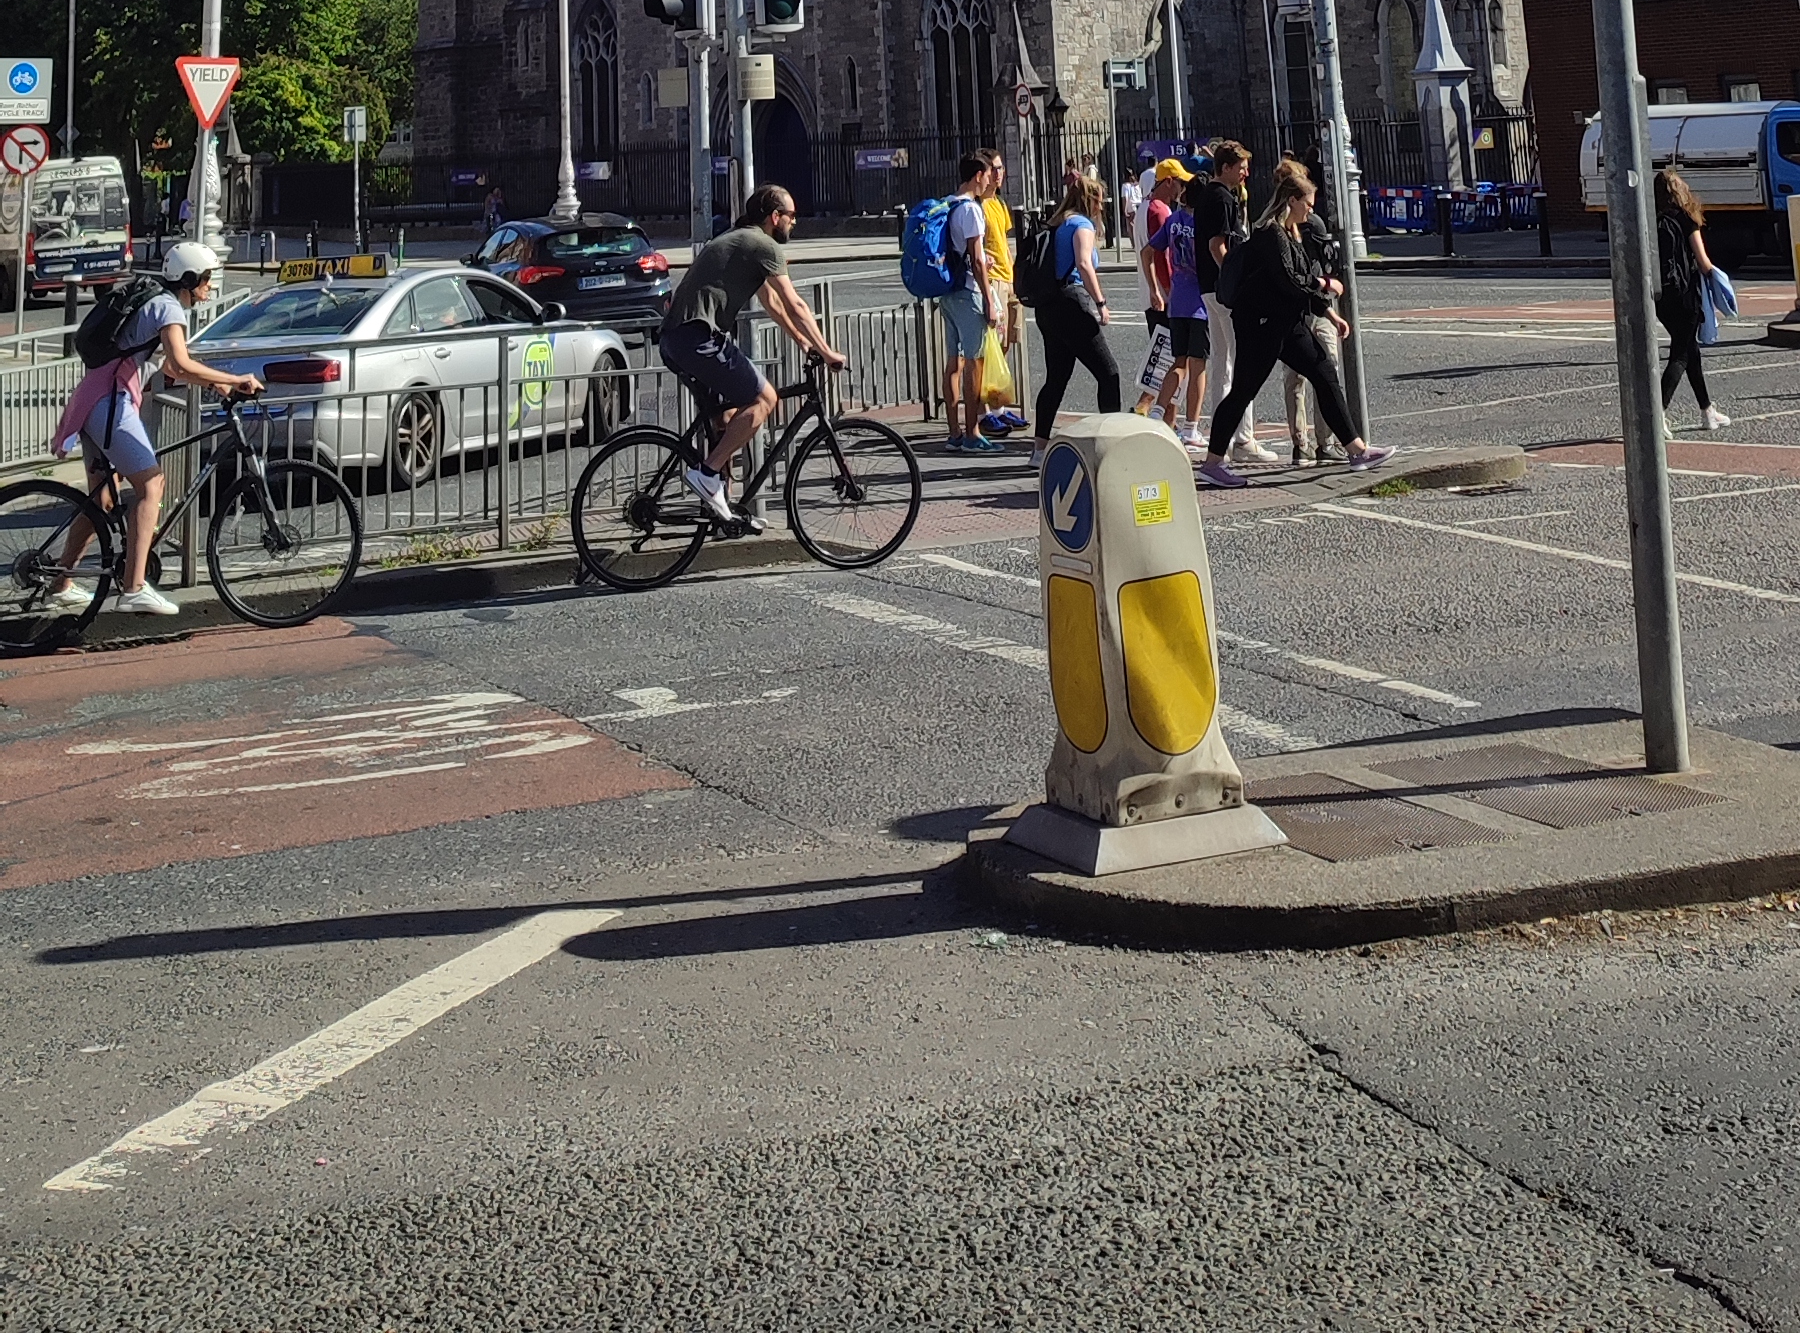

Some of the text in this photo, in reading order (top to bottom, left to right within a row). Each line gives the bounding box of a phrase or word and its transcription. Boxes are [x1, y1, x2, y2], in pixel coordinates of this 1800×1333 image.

[189, 67, 230, 82] YIELD
[316, 258, 350, 276] TAXI
[526, 359, 550, 378] TAXI
[1137, 487, 1158, 500] 573
